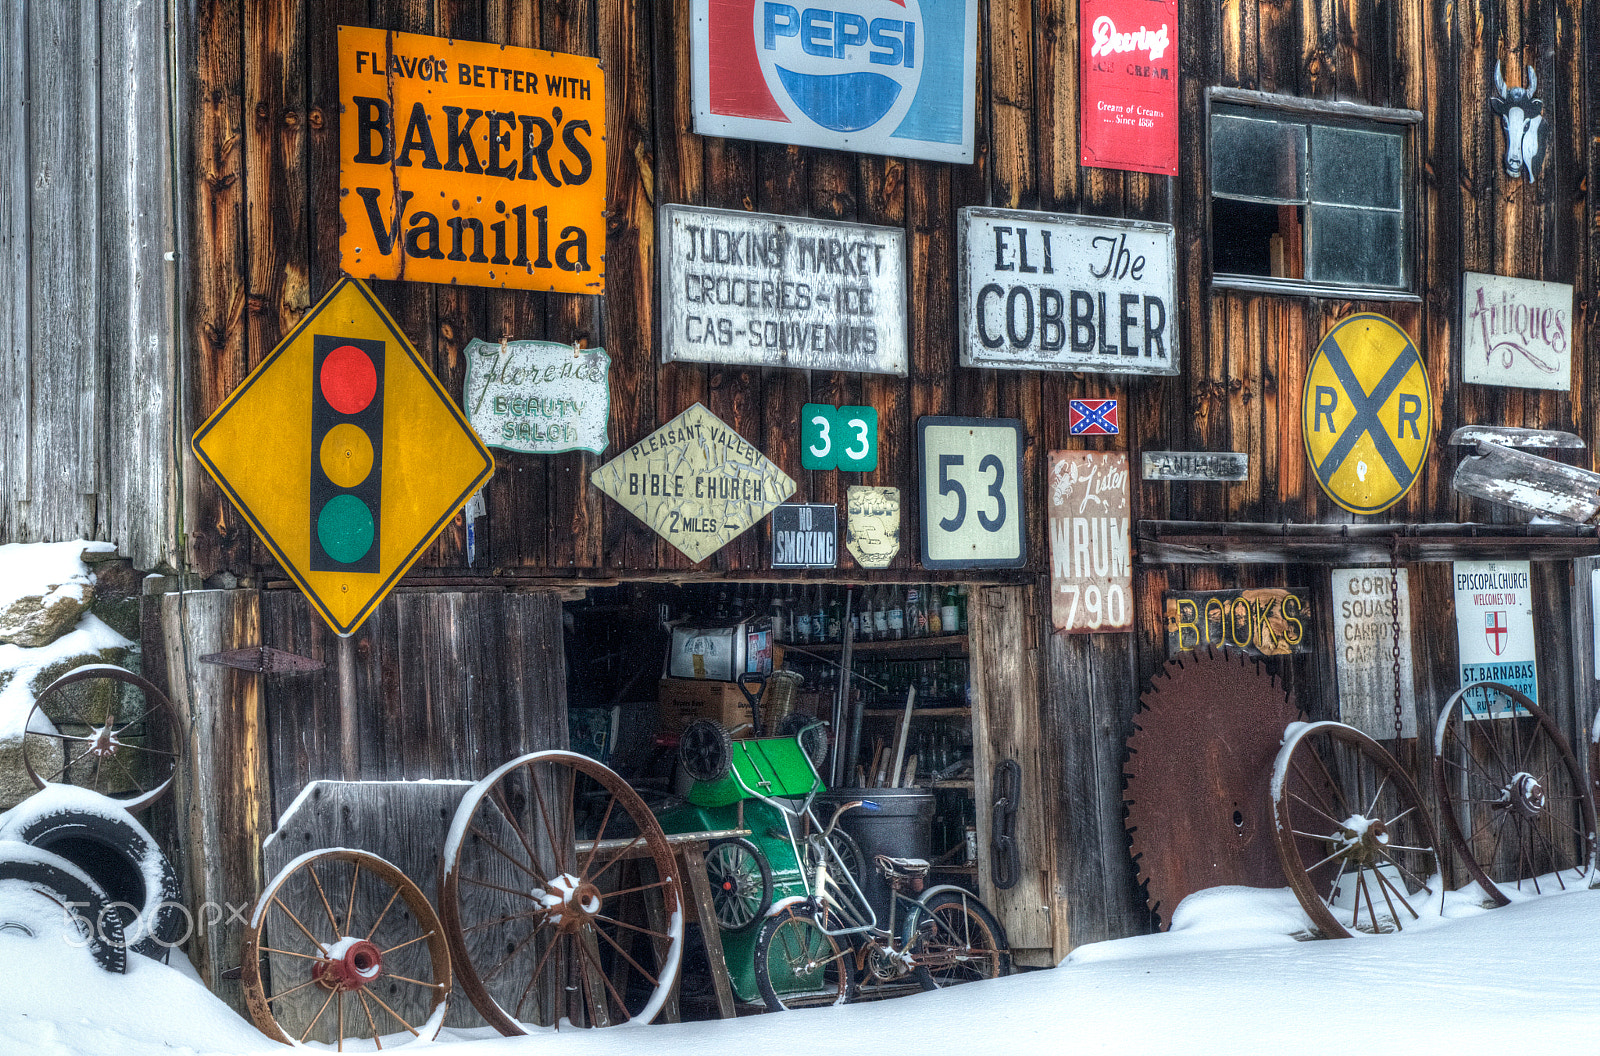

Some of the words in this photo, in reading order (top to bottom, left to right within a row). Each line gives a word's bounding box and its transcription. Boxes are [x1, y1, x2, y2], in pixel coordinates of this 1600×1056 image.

[764, 1, 915, 68] PEPSI
[356, 51, 448, 83] FLAVOR
[458, 63, 539, 95] BETTER
[545, 74, 591, 100] WITH
[1097, 101, 1123, 113] Cream
[1126, 104, 1134, 114] of
[1137, 105, 1164, 118] Creams
[352, 95, 593, 188] BAKER'S
[355, 187, 591, 272] Vanilla
[797, 236, 886, 278] MARKET
[993, 226, 1054, 274] ELI
[1089, 233, 1146, 281] The
[976, 283, 1166, 358] COBBLER
[474, 344, 600, 415] Florence
[494, 396, 586, 417] BEAUTY
[1314, 385, 1338, 433] R
[1398, 393, 1422, 440] R
[630, 424, 701, 461] PLEASANT
[710, 426, 763, 466] VALLEY
[629, 473, 684, 497] BIBLE
[695, 476, 762, 501] CHURCH
[939, 454, 1007, 532] 53
[1079, 465, 1128, 514] Listen
[670, 511, 679, 533] 2
[683, 517, 717, 532] MILES
[799, 507, 812, 531] NO
[777, 530, 834, 564] SMOKING
[1050, 517, 1130, 578] WRUM
[1457, 573, 1498, 590] EPISCOPAL
[1498, 572, 1528, 589] CHURCH
[1473, 593, 1503, 606] WELCOMES
[1504, 593, 1516, 605] YOU
[1060, 584, 1125, 630] 790
[1176, 594, 1303, 651] BOOKS
[1463, 668, 1478, 682] ST.
[1480, 664, 1534, 681] BARNABAS
